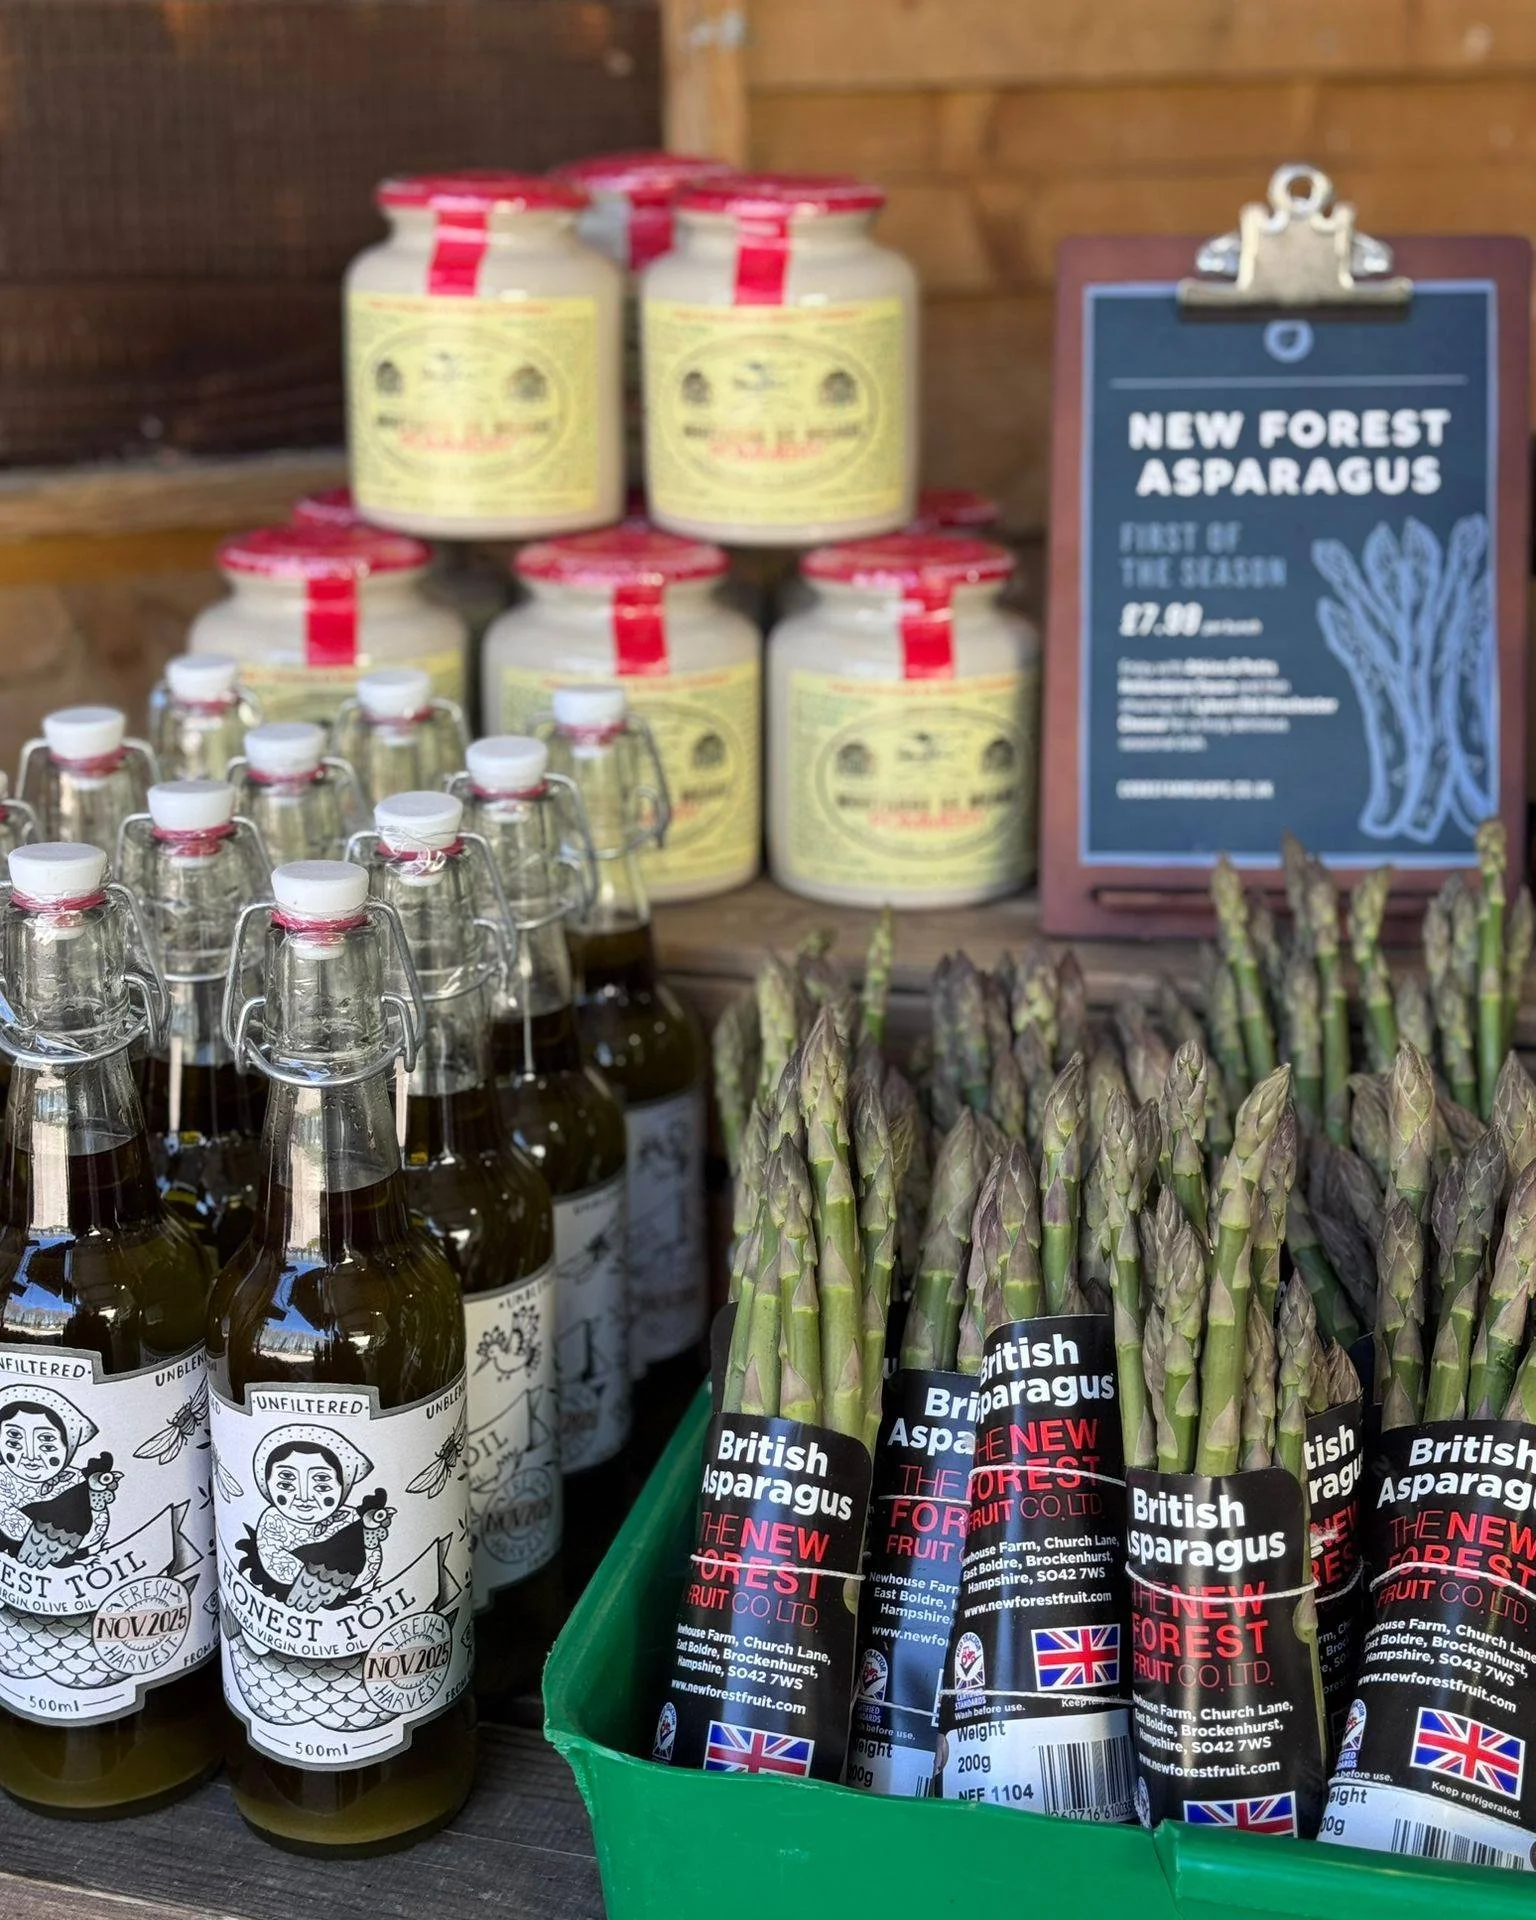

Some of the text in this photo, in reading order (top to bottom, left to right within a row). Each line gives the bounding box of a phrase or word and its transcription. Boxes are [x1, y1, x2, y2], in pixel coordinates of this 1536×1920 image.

[1129, 408, 1451, 450] NEW FOREST
[1136, 455, 1441, 497] ASPARAGUS
[1118, 520, 1243, 552] FIRST OF
[1119, 556, 1287, 589] THE SEASON
[0, 1357, 86, 1379] NFILTERED
[155, 1354, 208, 1387] UNBLEN
[258, 1395, 363, 1415] UNFILTERED
[977, 1374, 1116, 1424] paragus
[717, 1430, 829, 1478] British
[976, 1427, 1006, 1465] HE
[1009, 1418, 1099, 1454] NEW
[1303, 1424, 1355, 1471] tish
[1409, 1434, 1536, 1475] British
[701, 1464, 853, 1521] Asparagus
[899, 1464, 962, 1498] THE
[1376, 1471, 1536, 1512] Asparag
[890, 1499, 971, 1539] FOR
[1132, 1487, 1246, 1530] British
[701, 1511, 830, 1563] THE NEW
[886, 1535, 955, 1562] FRUIT
[999, 1541, 1041, 1554] Farm,
[1044, 1535, 1092, 1550] Church
[1095, 1534, 1119, 1548] Lane,
[1389, 1510, 1536, 1561] THE NEW
[0, 1551, 148, 1600] EST TOIL
[692, 1547, 823, 1600] OREST
[979, 1558, 1022, 1575] Boldre,
[1026, 1551, 1114, 1568] Brockenhurst,
[119, 1579, 173, 1607] FRESH
[869, 1571, 960, 1594] Newhouse Farm
[968, 1567, 1106, 1595] Hampshire, SO42 7WS
[1378, 1579, 1437, 1609] FRUIT
[33, 1602, 69, 1613] OLIVE
[75, 1599, 97, 1611] OIL
[222, 1562, 417, 1642] HONEST TOIL
[874, 1587, 948, 1611] East Boldre,
[964, 1591, 1112, 1619] www.newforestfruit.com
[1171, 1580, 1267, 1620] NEW
[230, 1598, 369, 1656] EXTRA VIRGIN OLIVE OIL
[389, 1616, 438, 1645] FRESH
[1132, 1611, 1269, 1659] FOREST
[1408, 1618, 1451, 1635] Farm,
[1455, 1624, 1507, 1650] Church
[1510, 1641, 1536, 1664] Lane
[103, 1636, 179, 1672] HARVEST
[688, 1641, 720, 1660] Boldre,
[723, 1648, 819, 1680] Brockenhurst,
[707, 1628, 739, 1647] Farm,
[743, 1636, 794, 1656] Church
[797, 1645, 831, 1666] Lane,
[1380, 1633, 1428, 1648] Boldre,
[1432, 1636, 1529, 1679] Brockenhurst,
[677, 1655, 804, 1691] Hampshire, SO42 7WS
[1133, 1652, 1174, 1685] FRUIT
[1365, 1649, 1435, 1666] Hampshire,
[1439, 1653, 1482, 1674] SO42
[1485, 1665, 1516, 1687] 7WS
[29, 1695, 79, 1713] 500ml
[374, 1672, 441, 1711] HARVEST
[671, 1678, 807, 1716] www.newforestfruit.com
[1357, 1672, 1517, 1713] www.newforestfruit.com
[974, 1705, 1001, 1716] before
[1005, 1703, 1026, 1713] use.
[1160, 1704, 1197, 1722] Farm,
[1200, 1706, 1255, 1721] Church
[1258, 1700, 1293, 1716] Lane,
[865, 1724, 916, 1741] before use.
[957, 1721, 1006, 1743] Weight
[1146, 1718, 1178, 1737] Boldre,
[1181, 1718, 1284, 1738] Brockenhurst,
[295, 1741, 349, 1757] 500ml
[1191, 1741, 1235, 1754] SO42
[1238, 1736, 1272, 1752] 7WS
[849, 1763, 875, 1788] 00g
[958, 1754, 992, 1774] 200g
[1340, 1769, 1394, 1783] before use.
[991, 1783, 1034, 1801] 1104
[1329, 1787, 1368, 1806] eight
[1431, 1781, 1522, 1820] Keep refrigerated.
[1320, 1815, 1345, 1836] 0g
